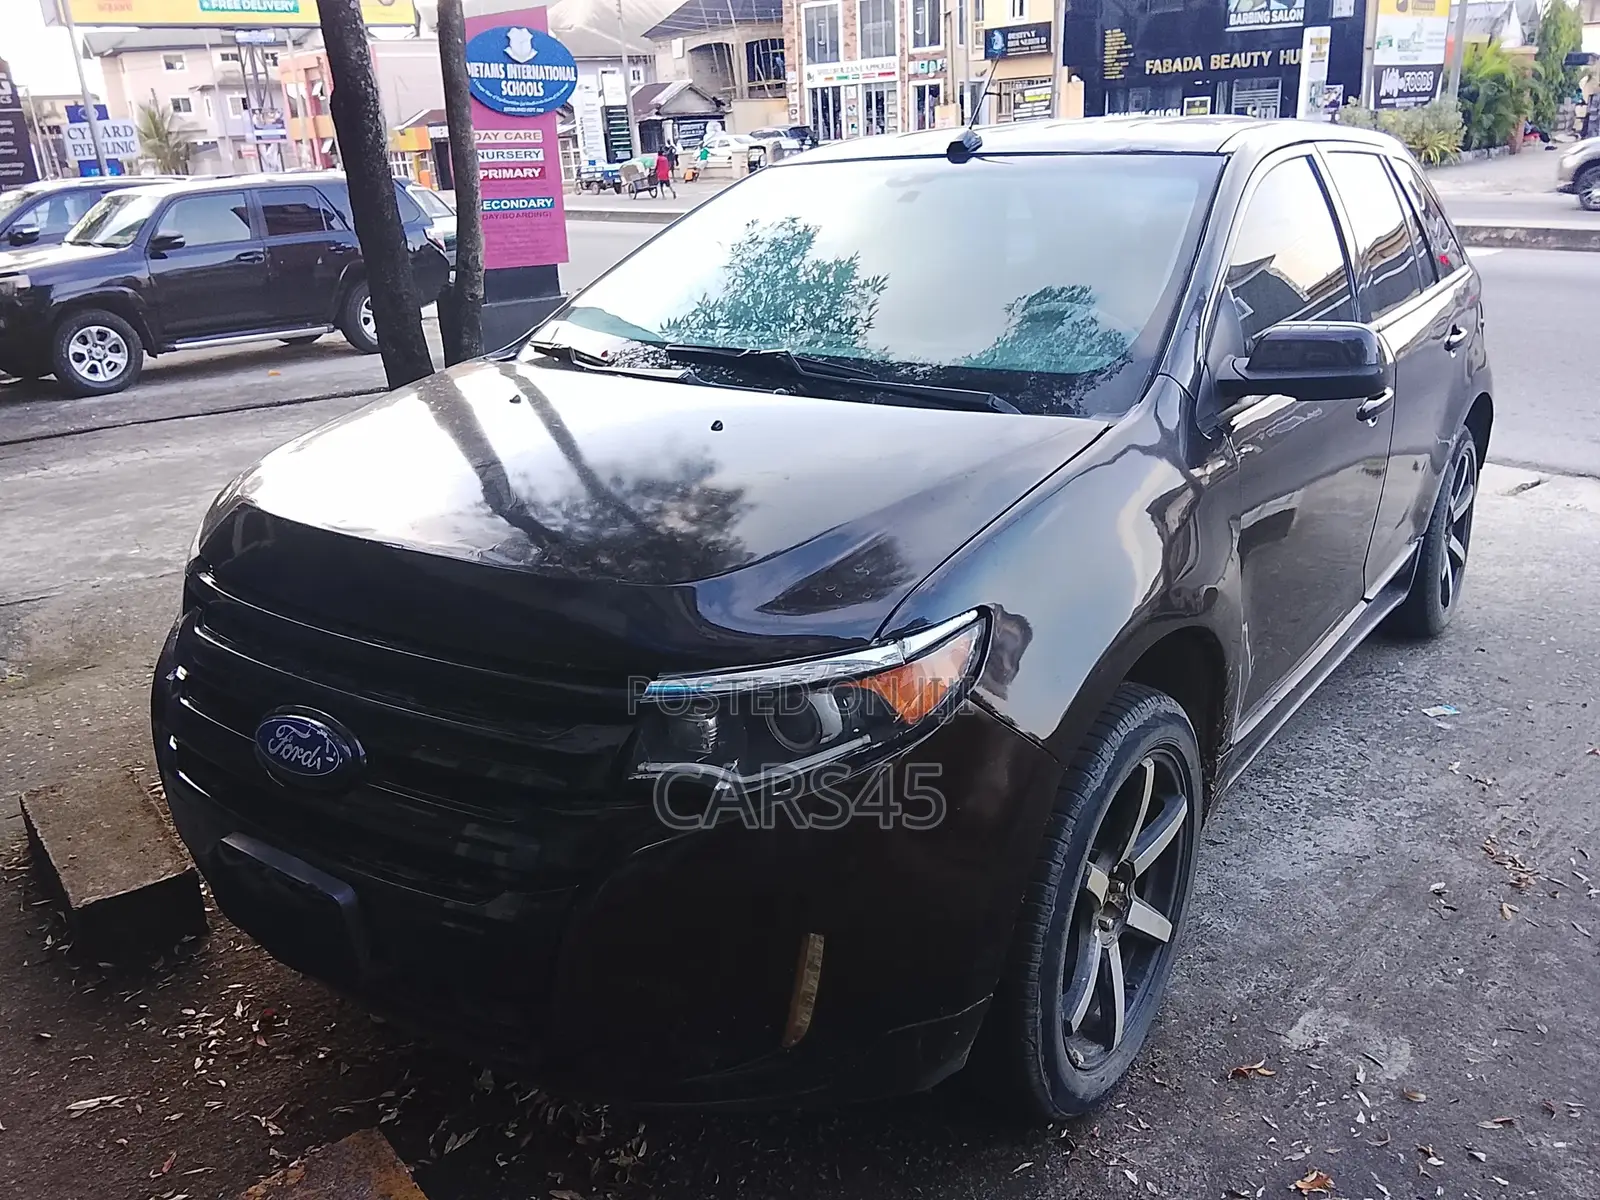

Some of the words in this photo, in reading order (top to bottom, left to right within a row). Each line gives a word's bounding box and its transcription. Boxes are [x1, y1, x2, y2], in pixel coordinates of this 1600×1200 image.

[1229, 10, 1270, 26] BARBING
[1271, 8, 1304, 22] SALON
[1145, 58, 1203, 75] FABADA
[1210, 51, 1271, 71] BEAUTY
[1279, 48, 1303, 65] HU
[507, 64, 577, 81] INTERNATIONAL
[501, 80, 544, 97] SCHOOLS
[1403, 71, 1434, 93] FOODS
[67, 125, 134, 140] CYARD
[473, 132, 499, 141] DAY
[504, 131, 542, 141] CARE
[72, 143, 96, 157] EYE
[477, 150, 541, 160] NURSERY
[480, 167, 542, 179] PRIMARY
[480, 198, 553, 210] ECONDARY
[481, 211, 551, 221] DAY/BOARDING)
[267, 724, 322, 769] Ford
